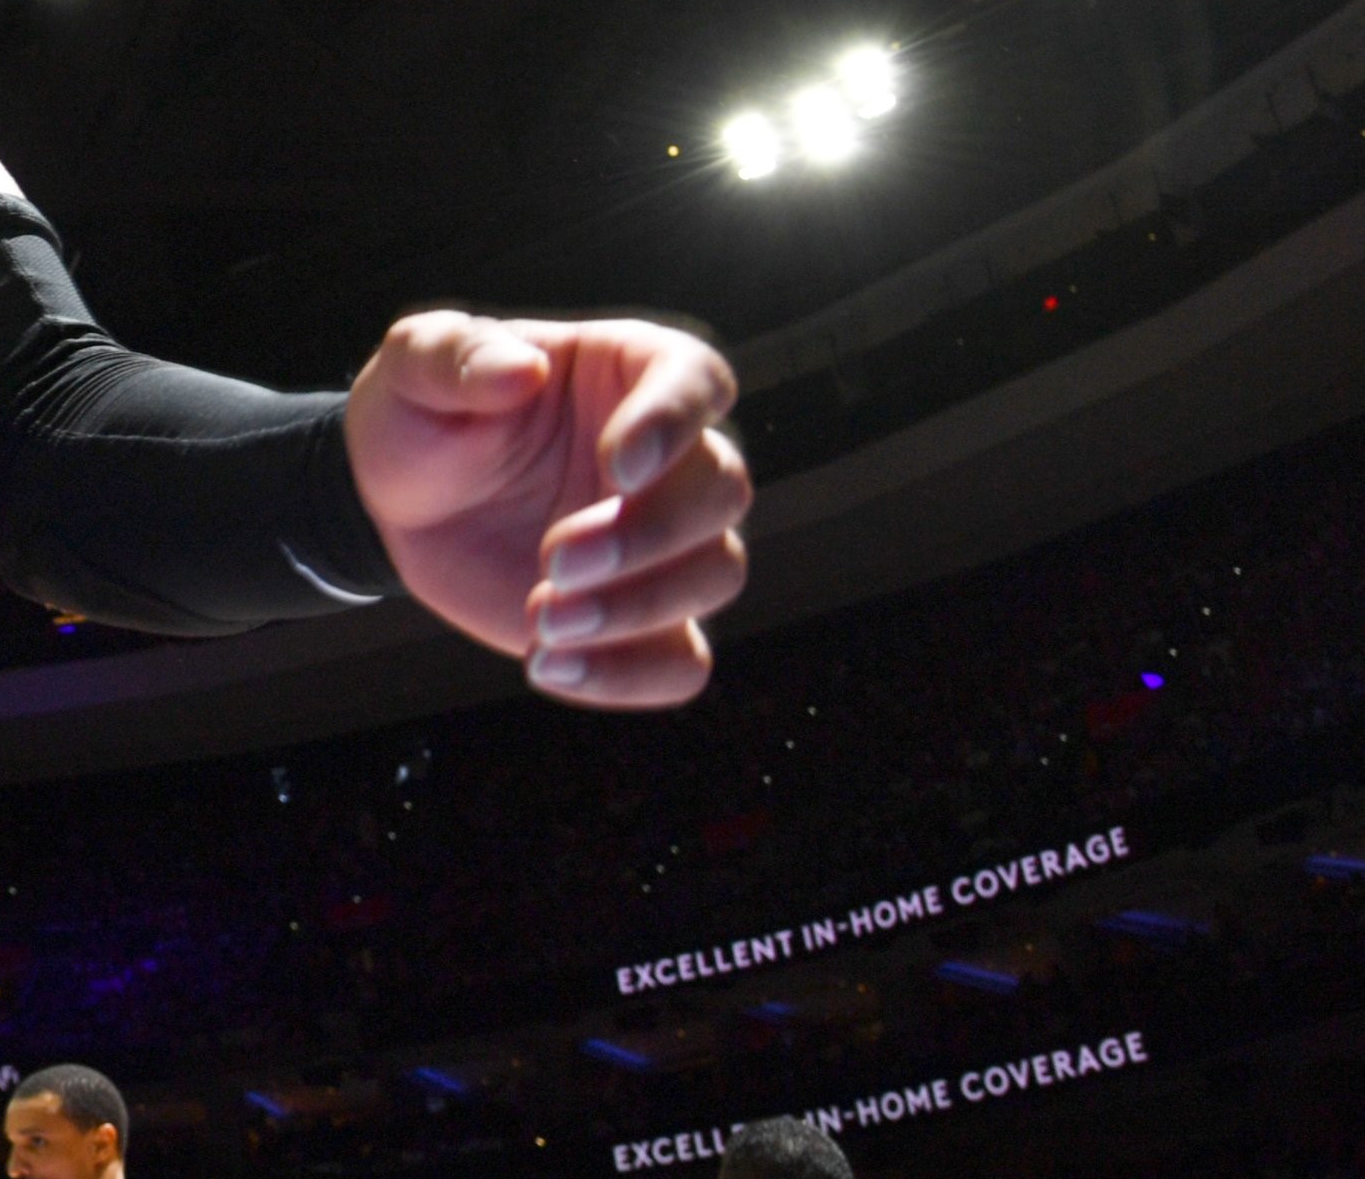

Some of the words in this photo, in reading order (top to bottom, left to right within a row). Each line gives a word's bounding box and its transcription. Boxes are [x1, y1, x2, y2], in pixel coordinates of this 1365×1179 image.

[615, 929, 795, 996] EXCELLENT
[802, 885, 944, 955] IN-HOME
[950, 826, 1133, 908] COVERAGE
[612, 1120, 746, 1174] EXCELL
[960, 1031, 1151, 1103] COVERAGE
